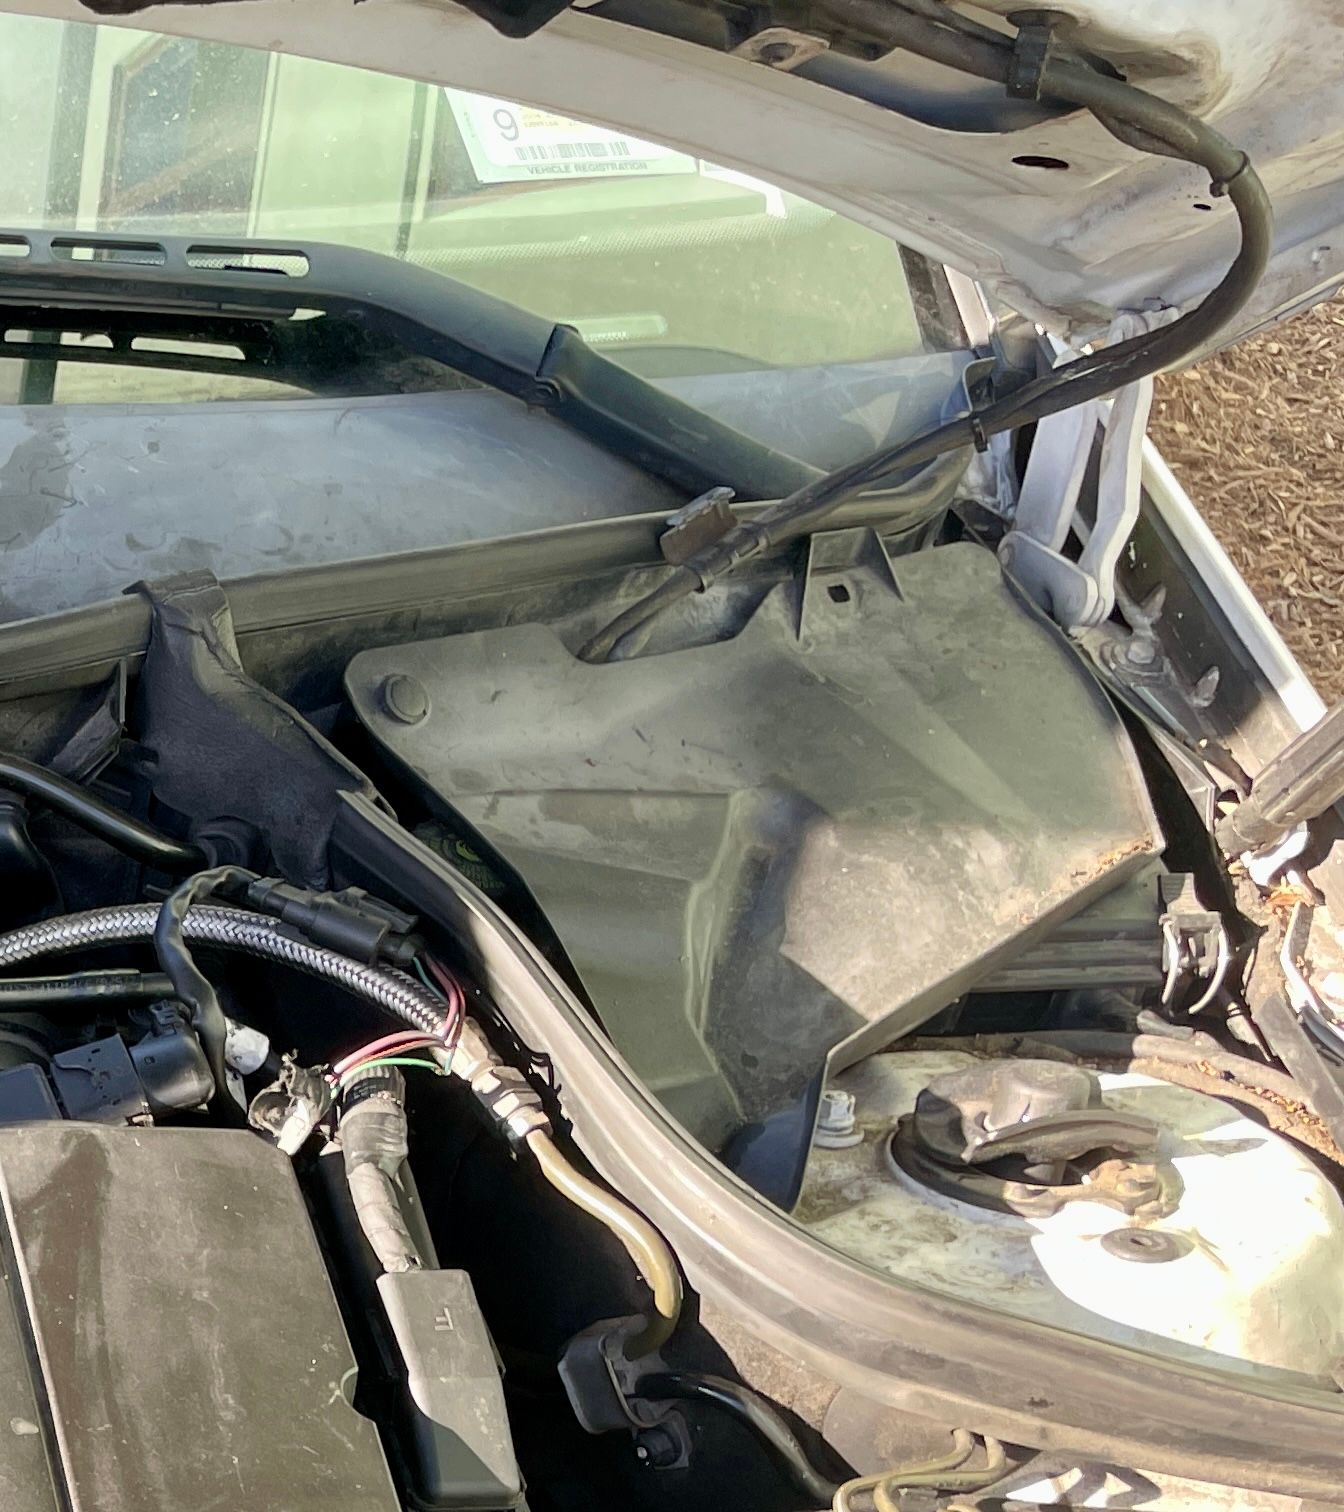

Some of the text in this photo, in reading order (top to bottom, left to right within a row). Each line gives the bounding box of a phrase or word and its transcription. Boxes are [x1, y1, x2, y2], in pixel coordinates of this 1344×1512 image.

[492, 108, 520, 141] 9
[527, 161, 648, 176] VEHICLE REGISTRATION
